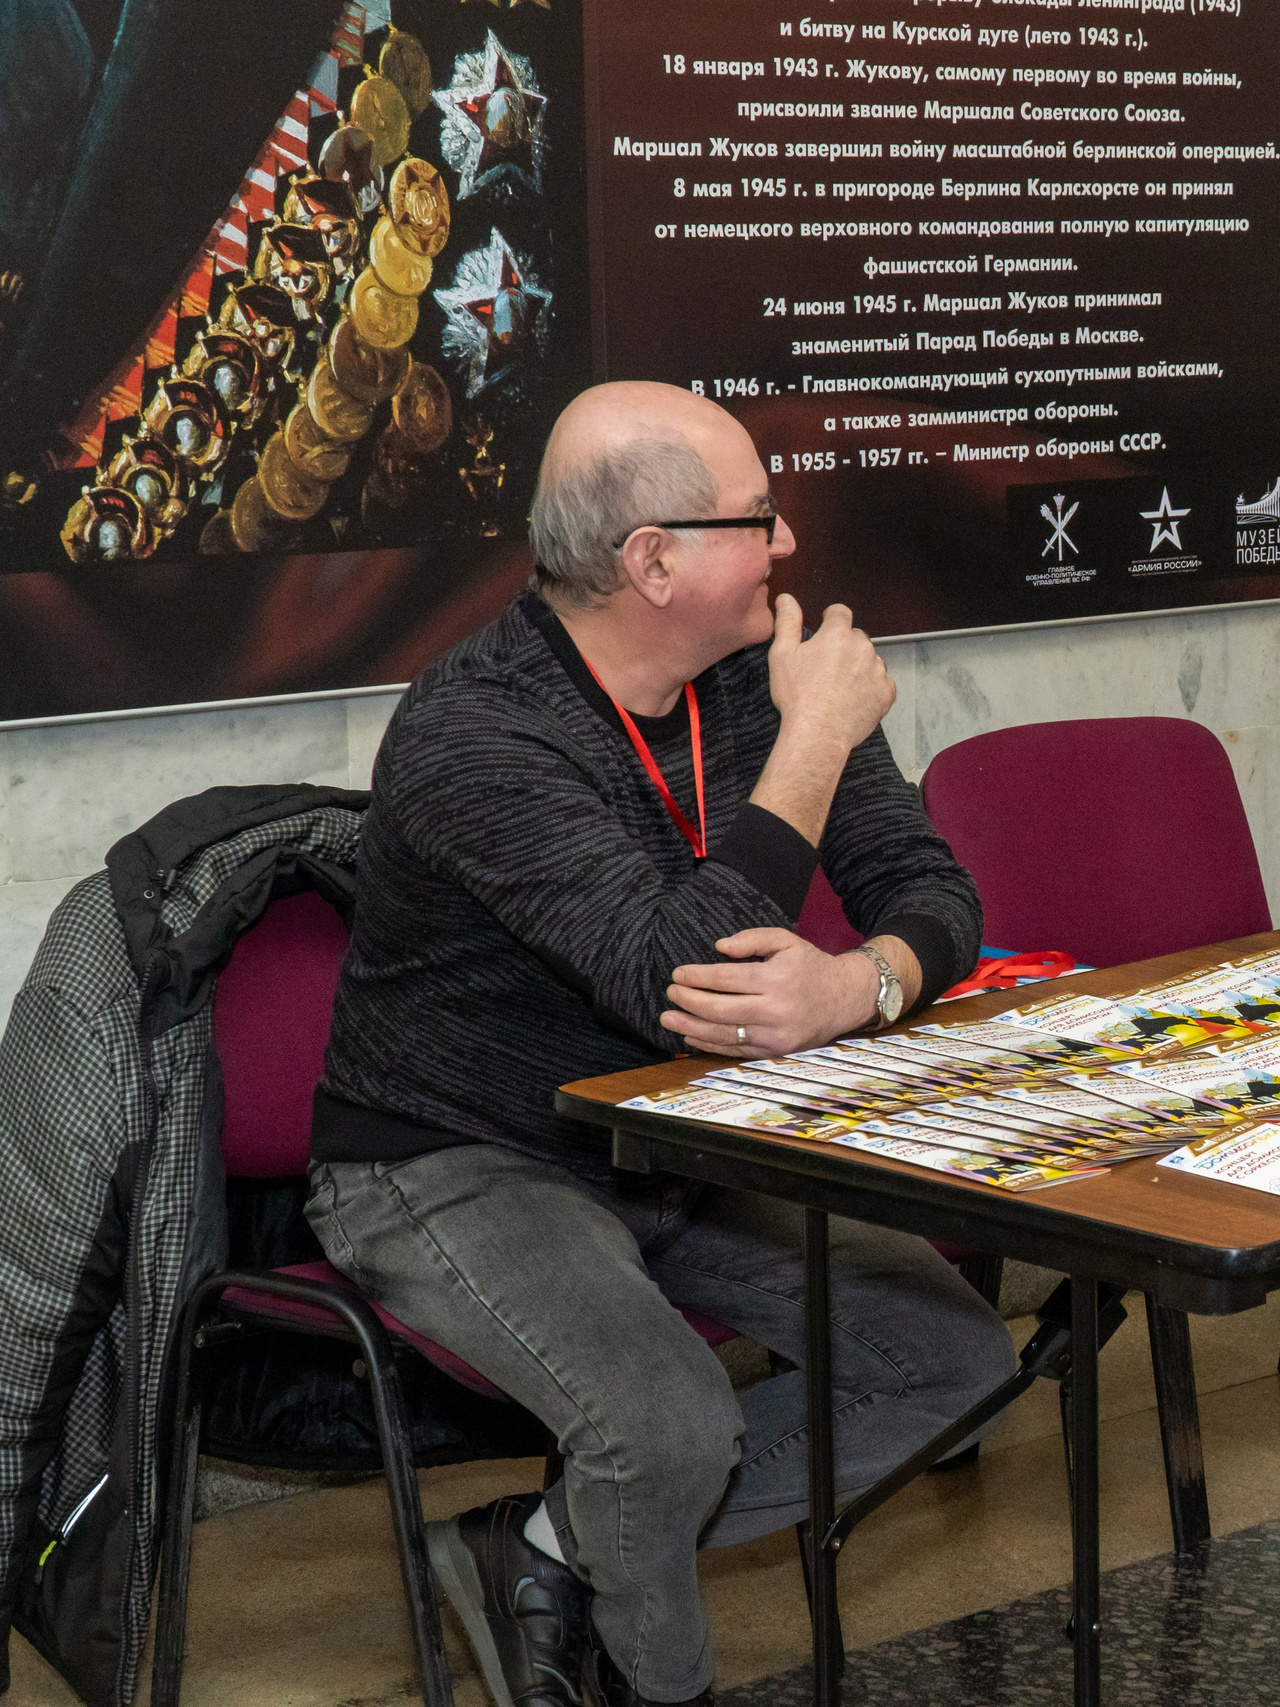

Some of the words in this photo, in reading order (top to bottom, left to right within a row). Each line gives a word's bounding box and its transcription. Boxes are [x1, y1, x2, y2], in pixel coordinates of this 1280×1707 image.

[1190, 0, 1241, 18] (1943)
[779, 22, 793, 36] и
[799, 16, 856, 43] битву
[861, 24, 886, 39] на
[892, 20, 972, 45] Курской
[977, 28, 1019, 48] дуге
[1024, 24, 1072, 49] (лето
[1078, 27, 1119, 46] 1943
[1124, 27, 1148, 52] г.).
[662, 54, 686, 75] 18
[692, 60, 765, 81] января
[773, 56, 819, 78] 1943
[825, 63, 840, 78] г.
[845, 59, 929, 85] Жукову,
[935, 66, 1007, 86] самому
[1012, 68, 1091, 88] первому
[1096, 70, 1118, 84] во
[1123, 71, 1177, 89] время
[1182, 68, 1242, 90] войны,
[737, 102, 844, 122] присвоили
[850, 103, 918, 119] звание
[923, 100, 1015, 124] Маршала
[1020, 101, 1119, 122] Советского
[1124, 103, 1186, 123] Союза.
[613, 136, 702, 161] Маршал
[708, 137, 779, 162] Жуков
[784, 142, 883, 162] завершил
[889, 139, 947, 163] войну
[952, 139, 1067, 159] масштабной
[1072, 139, 1177, 164] берлинской
[1182, 142, 1280, 164] операцией.
[673, 177, 686, 198] 8
[692, 182, 732, 197] мая
[741, 177, 787, 198] 1945
[793, 183, 808, 197] г.
[814, 183, 826, 197] в
[832, 182, 935, 202] пригороде
[941, 178, 1021, 201] Берлина
[1027, 178, 1139, 201] Карлсхорсте
[1144, 182, 1167, 196] он
[1172, 182, 1234, 200] принял
[654, 224, 678, 239] от
[684, 222, 794, 241] немецкого
[800, 221, 913, 242] верховного
[918, 220, 1055, 238] командования
[1060, 219, 1130, 238] полную
[1135, 218, 1250, 237] капитуляцию
[863, 254, 978, 280] фашистской
[984, 254, 1078, 277] Германии.
[762, 297, 787, 317] 24
[793, 301, 846, 316] июня
[853, 294, 897, 314] 1945
[903, 299, 917, 313] г.
[923, 293, 1002, 316] Маршал
[1007, 291, 1069, 314] Жуков
[1074, 292, 1162, 312] принимал
[791, 333, 910, 356] знаменитый
[916, 332, 977, 354] Парад
[982, 328, 1054, 350] Победы
[1060, 332, 1070, 345] в
[1075, 326, 1144, 345] Москве.
[691, 379, 705, 397] В
[713, 377, 760, 398] 1946
[766, 381, 781, 395] г.
[802, 367, 1009, 394] Главнокомандующий
[1014, 366, 1131, 388] сухопутными
[1137, 360, 1224, 379] войсками,
[823, 417, 836, 432] а
[842, 414, 902, 430] также
[907, 407, 1028, 427] замминистра
[1034, 400, 1119, 423] обороны.
[770, 454, 784, 474] В
[791, 451, 836, 472] 1955
[858, 447, 902, 468] 1957
[908, 451, 929, 465] гг.
[953, 443, 1030, 463] Министр
[1035, 437, 1114, 460] обороны
[1119, 432, 1167, 452] СССР.
[1214, 1151, 1257, 1174] КОНЦЕРТ
